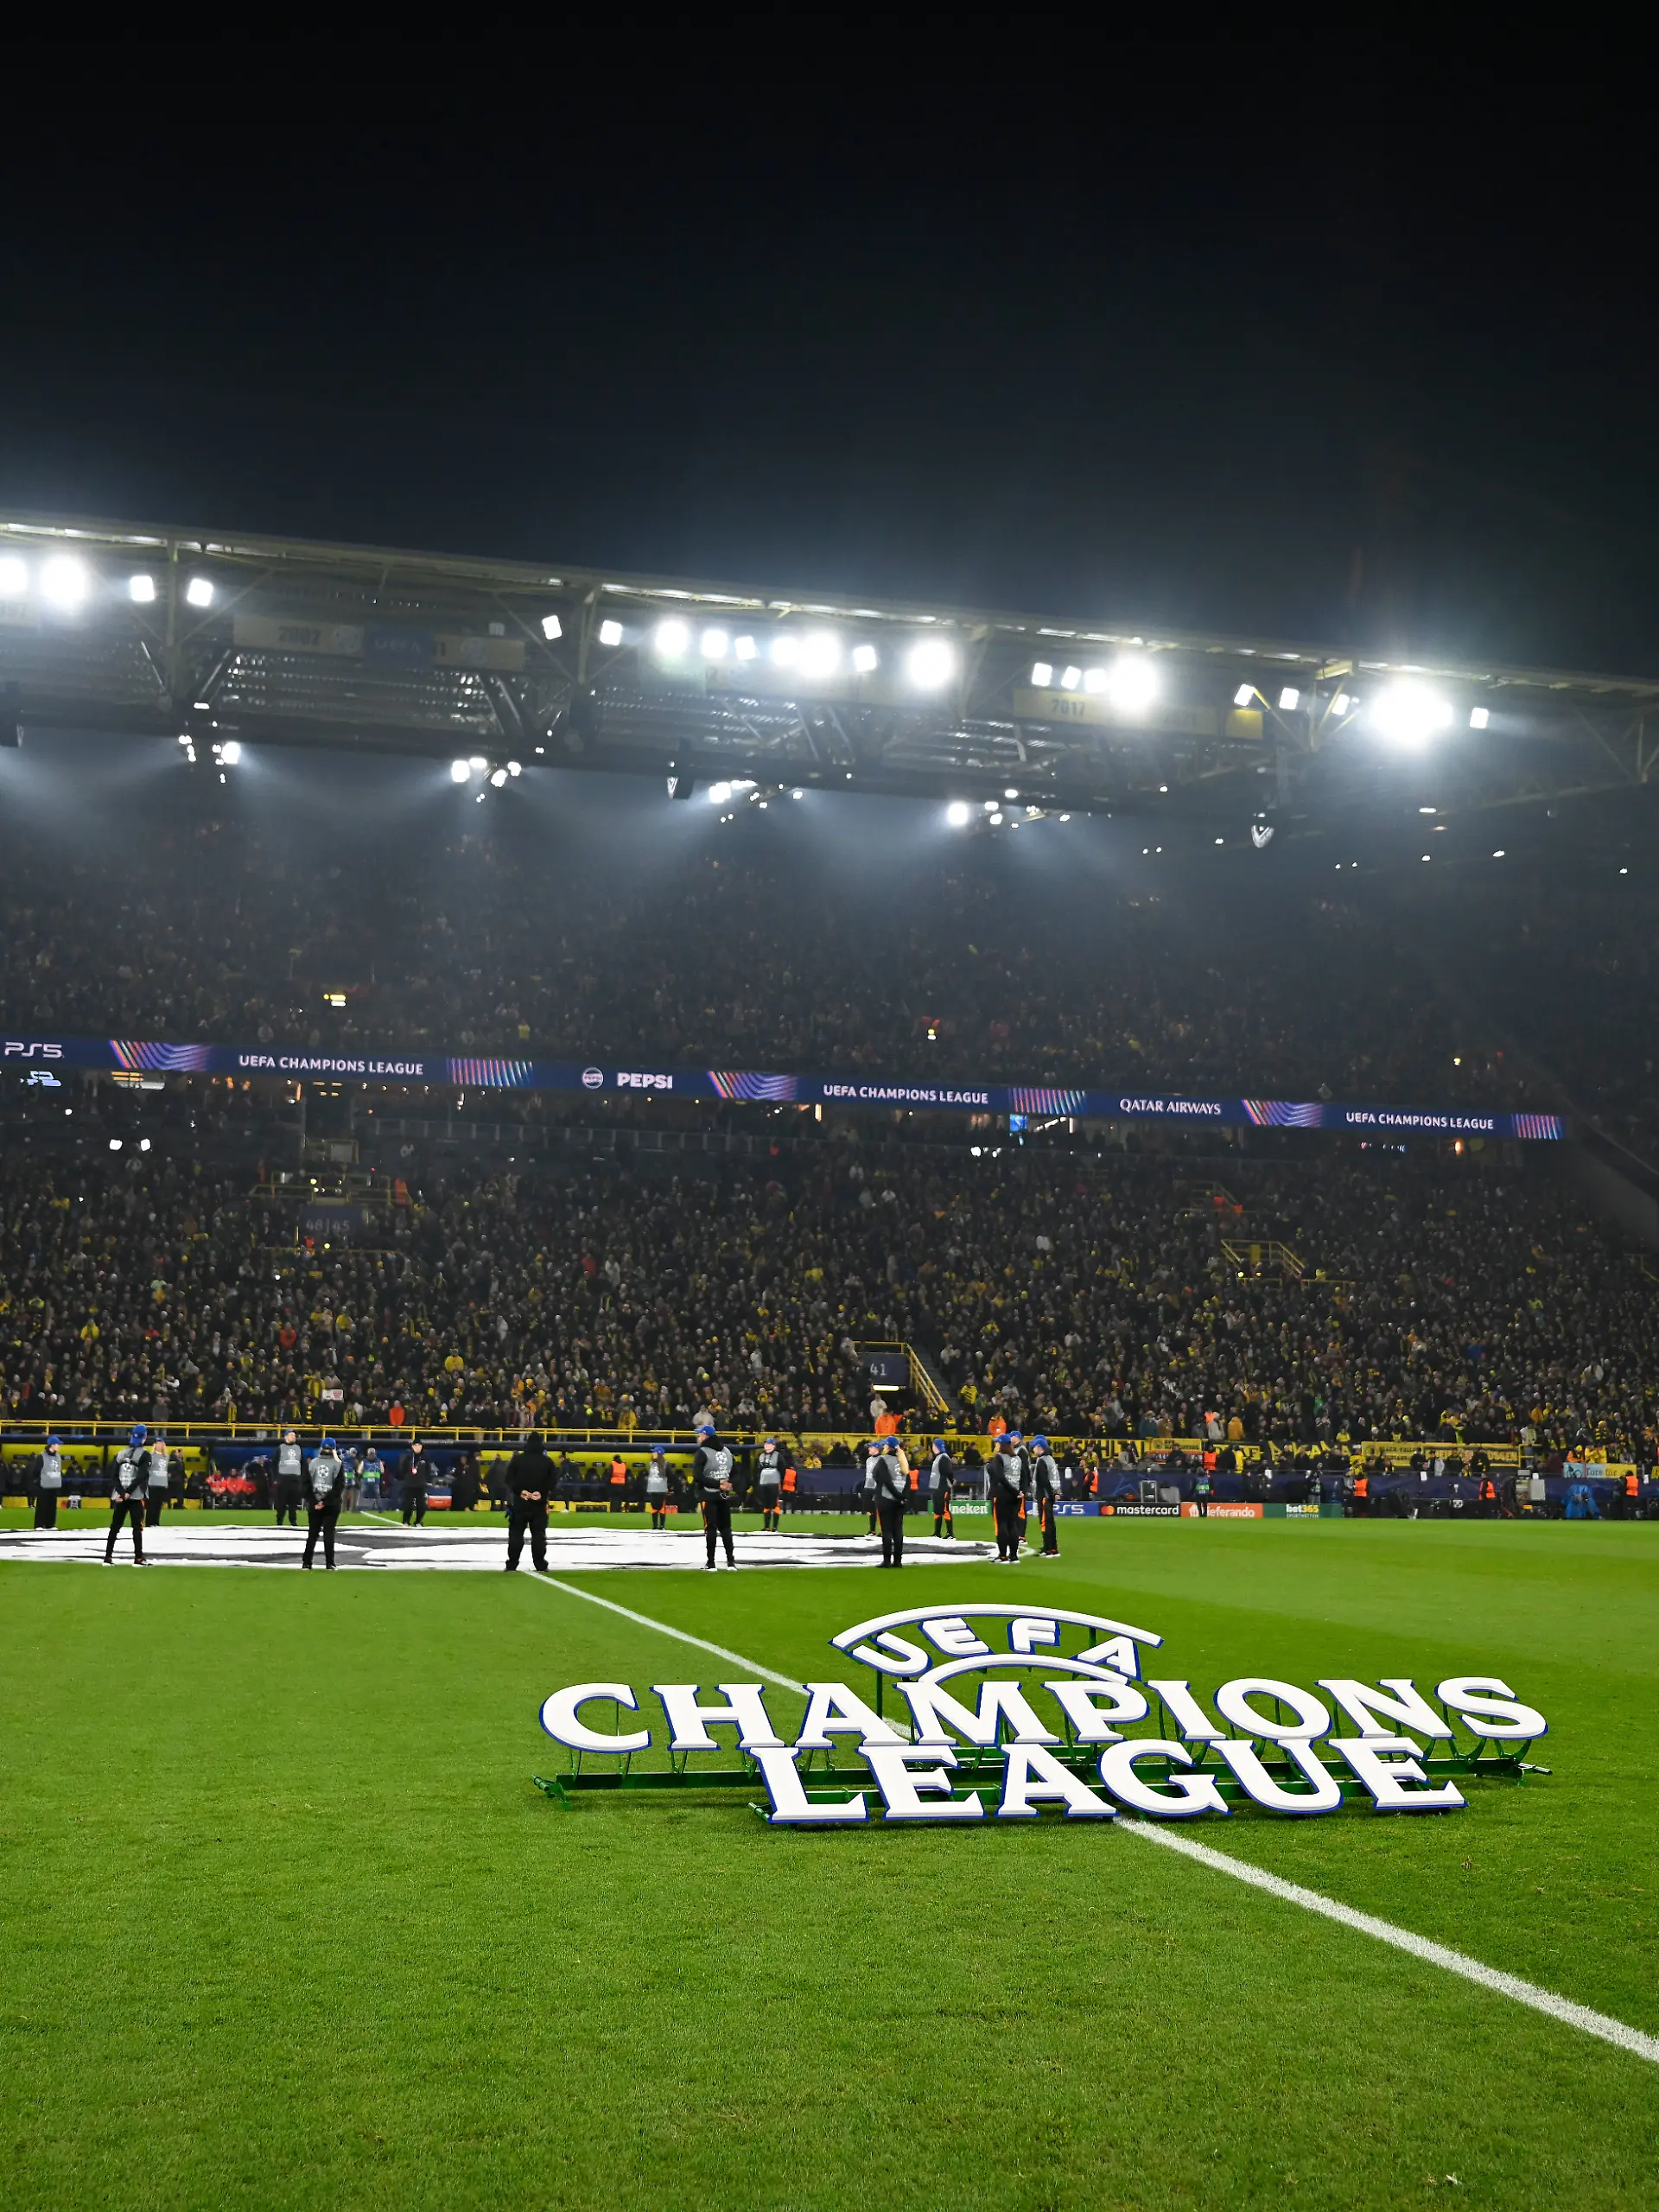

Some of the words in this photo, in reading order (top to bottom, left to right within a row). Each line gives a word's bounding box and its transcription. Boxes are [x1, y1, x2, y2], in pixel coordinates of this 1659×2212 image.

[1051, 697, 1086, 716] 2017
[4, 1041, 63, 1058] PS5
[238, 1054, 276, 1069] UEFA
[280, 1056, 365, 1073] CHAMPIONS
[369, 1060, 424, 1076] LEAGUE
[616, 1071, 673, 1090] PEPSI
[823, 1084, 857, 1098] UEFA
[859, 1085, 937, 1103] CHAMPIONS
[939, 1089, 988, 1104] LEAGUE
[1119, 1098, 1164, 1114] QATAR
[1166, 1100, 1222, 1116] AIRWAYS
[1346, 1111, 1376, 1125] UEFA
[1378, 1113, 1447, 1128] CHAMPIONS
[1450, 1116, 1494, 1130] LEAGUE
[869, 1363, 887, 1376] 41
[1052, 1504, 1084, 1514] PS5
[1116, 1504, 1179, 1516] mastercard
[1207, 1506, 1255, 1517] ieferando
[1286, 1503, 1319, 1513] bet365
[849, 1617, 1141, 1681] UEFA
[539, 1677, 1548, 1752] CHAMPIONS
[748, 1737, 1469, 1823] LEAGUE
